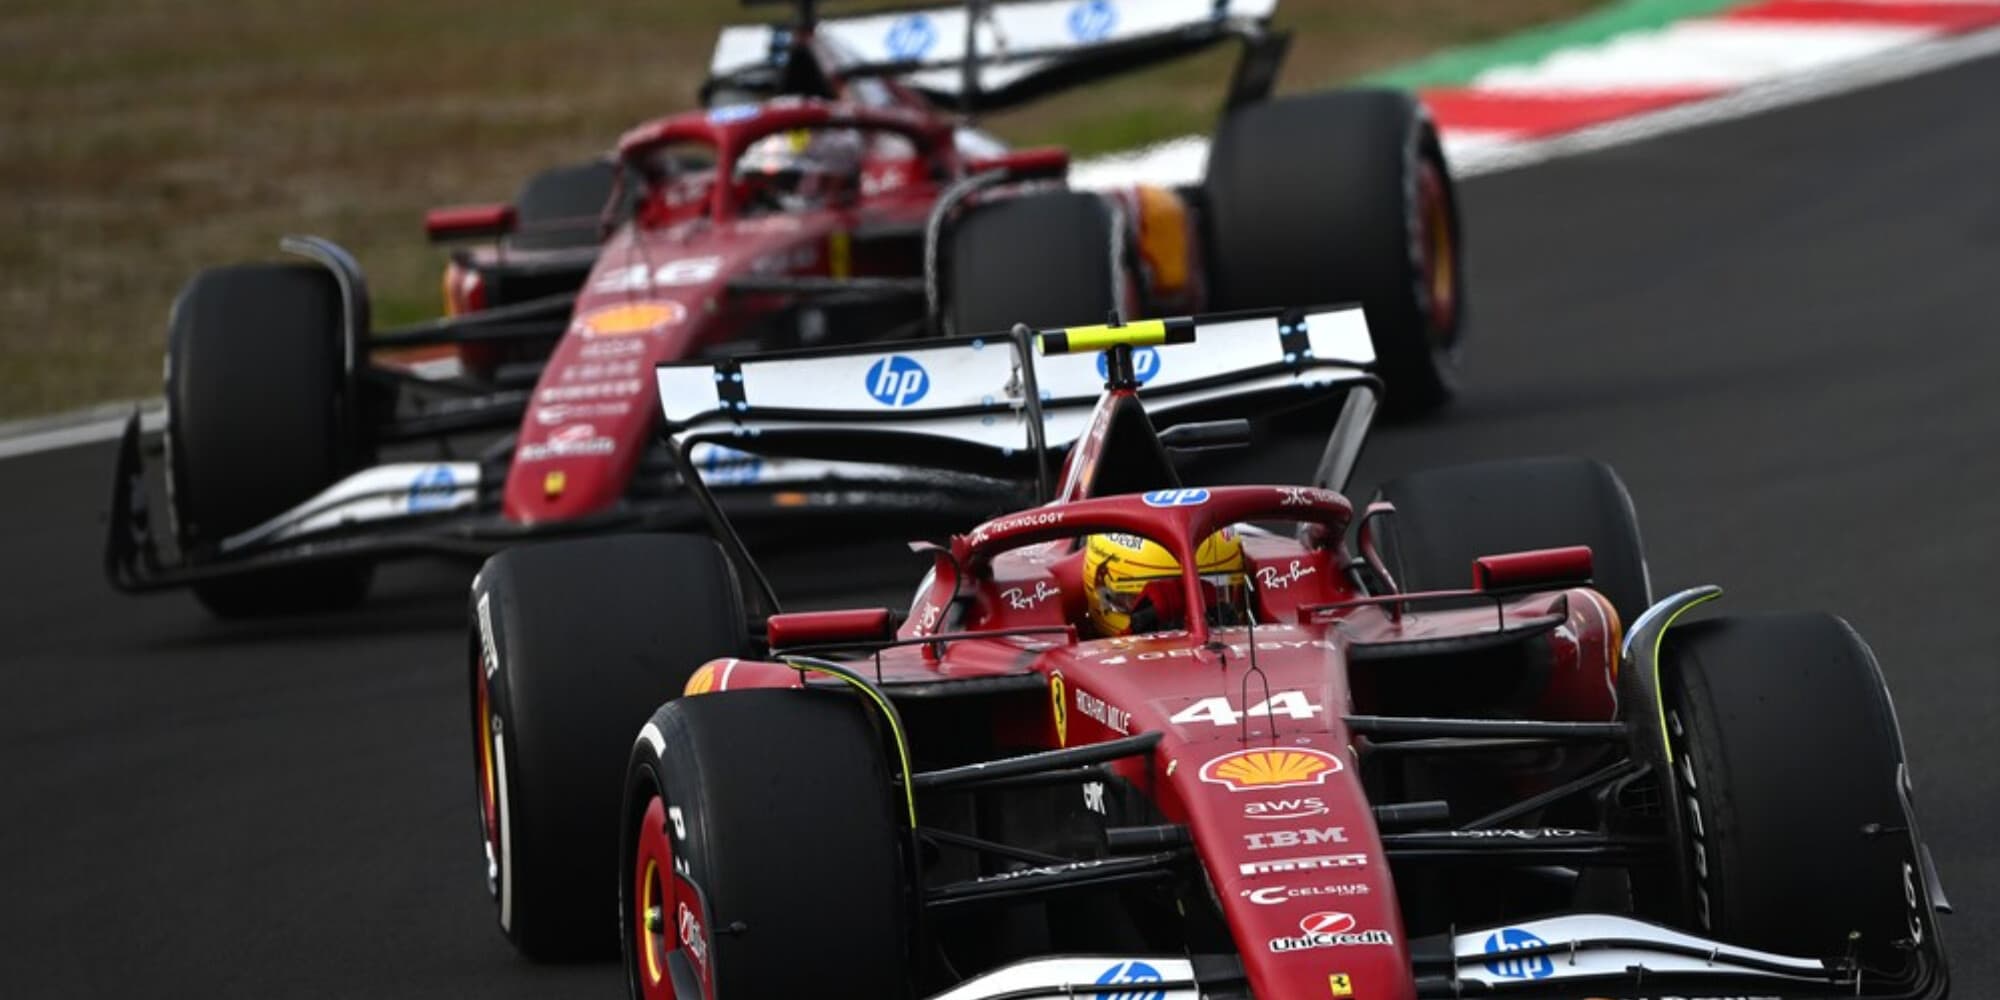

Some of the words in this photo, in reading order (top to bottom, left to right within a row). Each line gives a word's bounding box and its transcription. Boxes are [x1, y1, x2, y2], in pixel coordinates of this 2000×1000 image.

[869, 356, 928, 405] hp
[1144, 489, 1209, 507] hp
[991, 511, 1065, 534] TECHNOLOGY
[1256, 560, 1317, 589] Ray-Ban
[1001, 581, 1061, 610] Ray-Ban
[1169, 690, 1323, 727] 44
[1244, 797, 1325, 814] aws
[1243, 827, 1349, 851] IBM
[1239, 854, 1368, 876] PIRELLI
[1287, 884, 1369, 897] CELSIUS
[1270, 930, 1393, 953] UniCredit
[1484, 927, 1553, 980] hp
